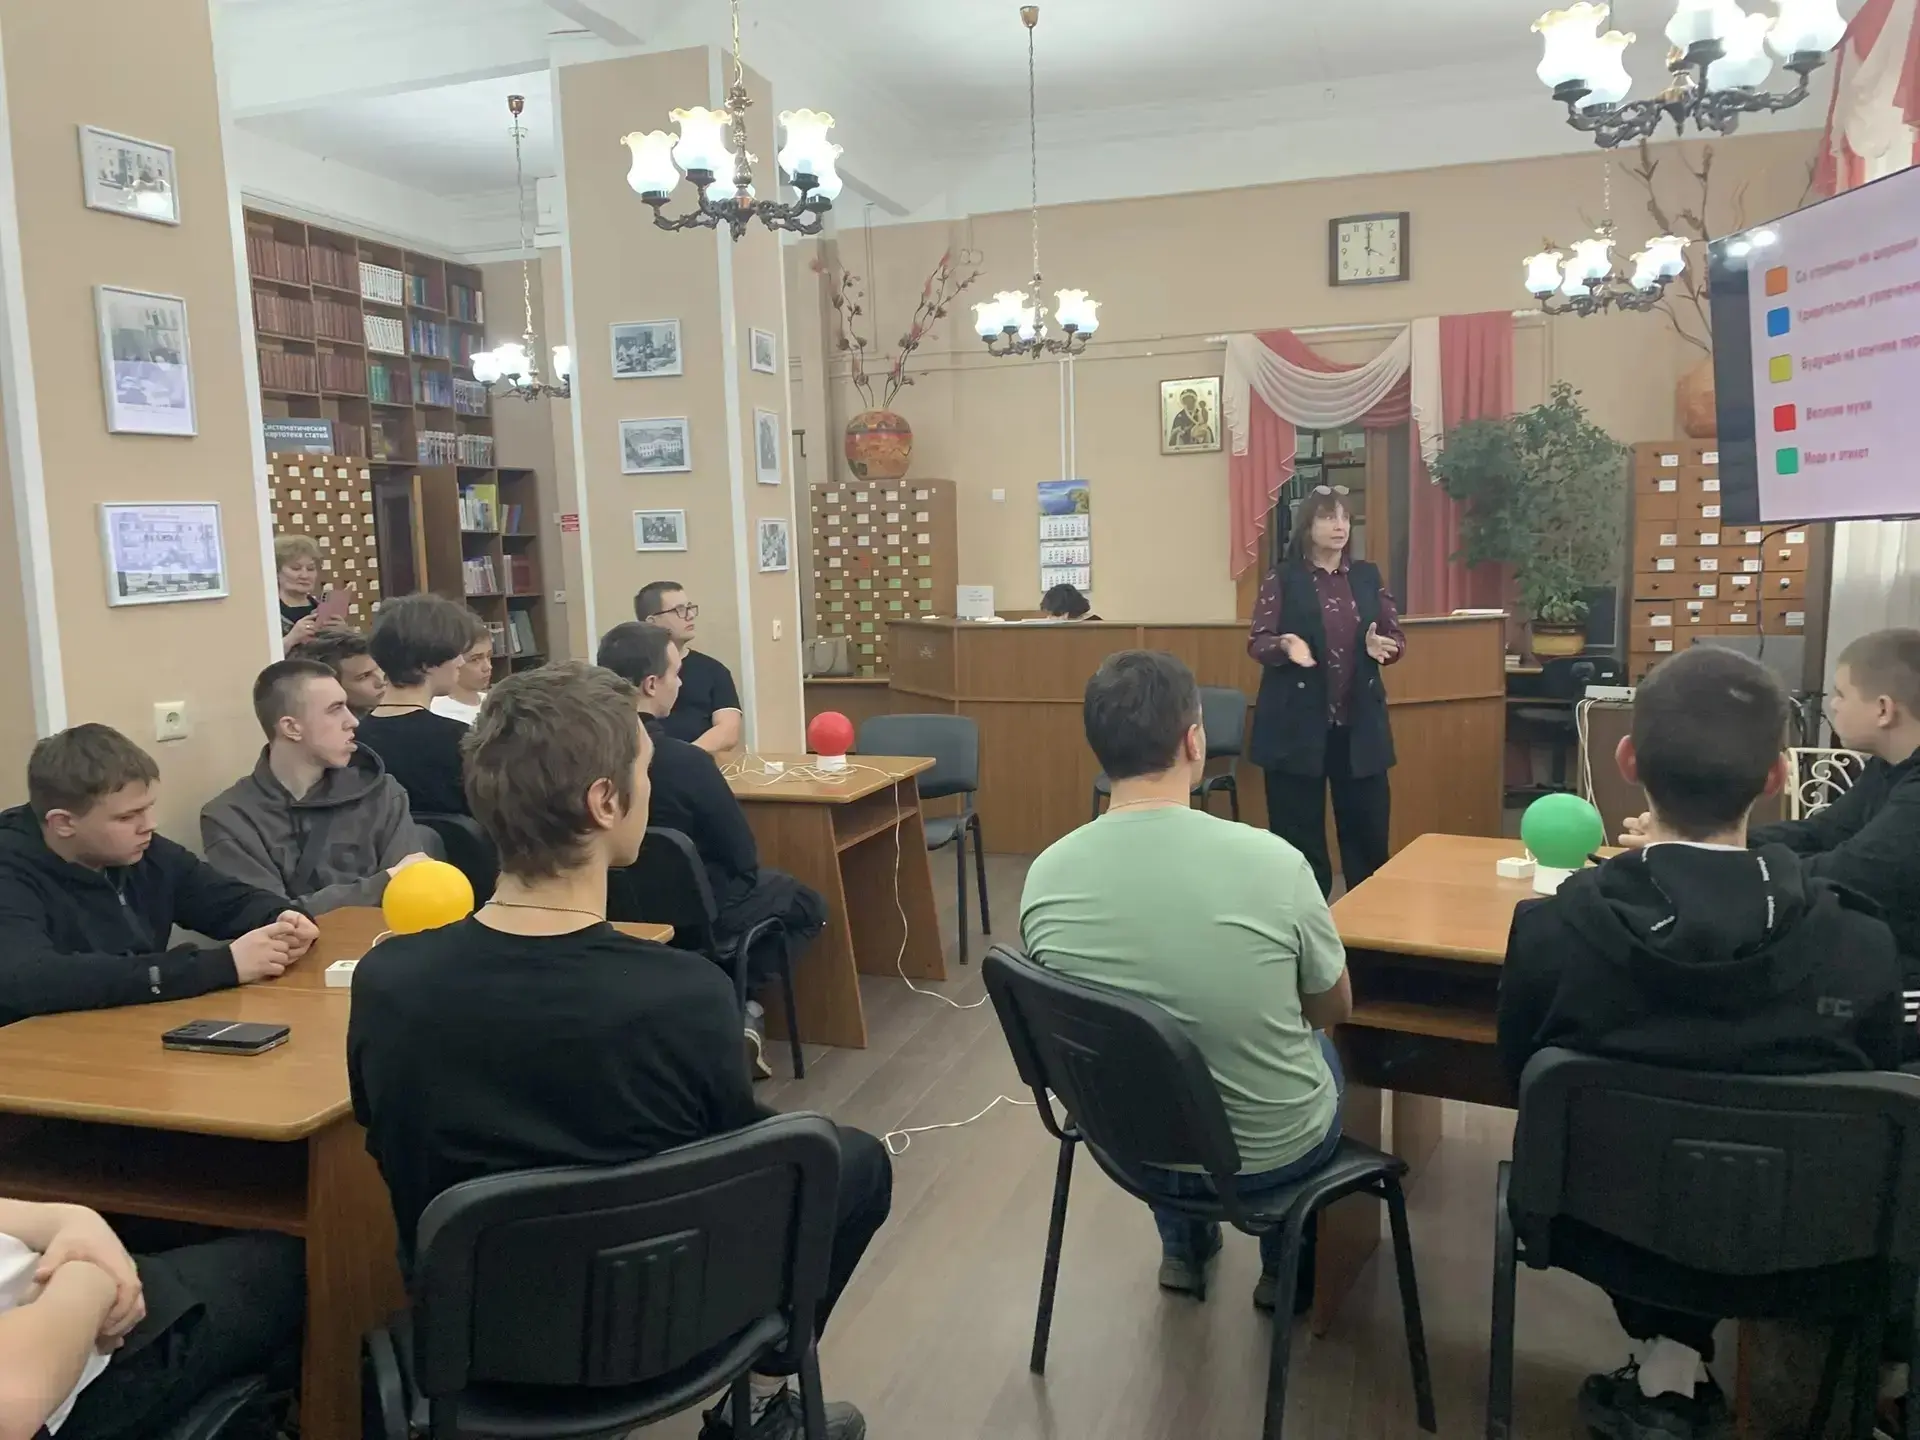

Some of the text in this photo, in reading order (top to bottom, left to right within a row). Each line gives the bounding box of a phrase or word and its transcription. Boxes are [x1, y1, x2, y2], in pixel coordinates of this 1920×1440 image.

[1341, 233, 1350, 243] 10
[1389, 229, 1396, 239] 2
[1391, 242, 1397, 252] 3
[1341, 247, 1348, 257] 9
[1389, 256, 1396, 264] 4
[1353, 268, 1360, 277] 7
[1366, 267, 1372, 277] 6
[1379, 266, 1386, 275] 5
[263, 423, 327, 432] Систематическая
[265, 431, 329, 439] картотека статей
